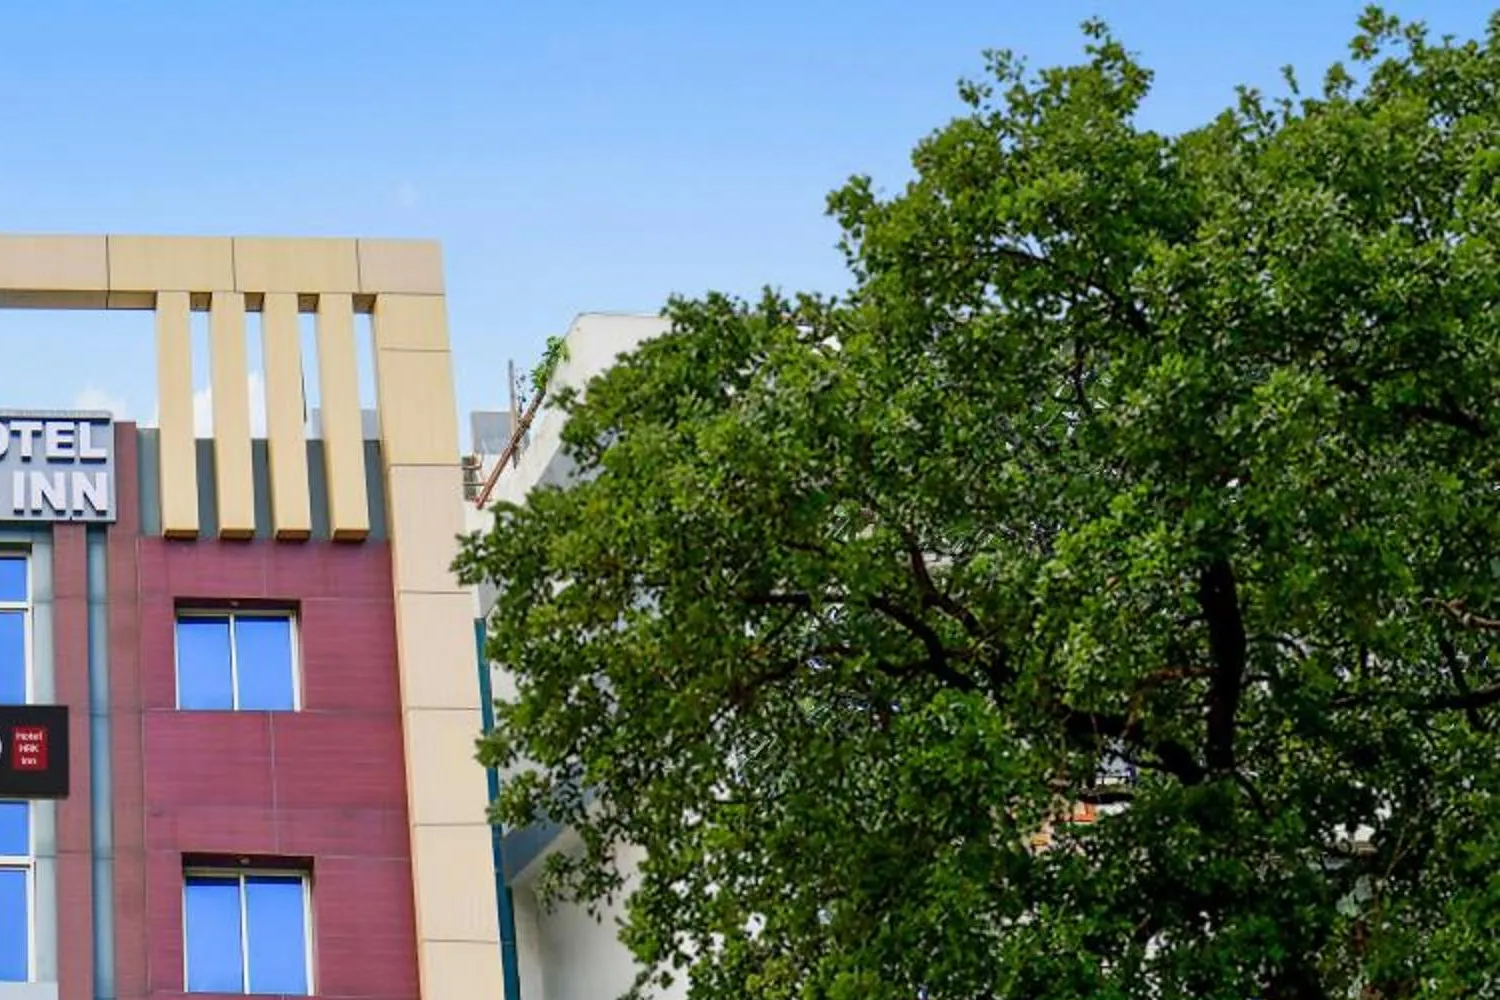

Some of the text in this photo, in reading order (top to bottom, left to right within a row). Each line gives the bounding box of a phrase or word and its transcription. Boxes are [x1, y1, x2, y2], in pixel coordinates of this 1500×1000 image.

[13, 470, 108, 516] INN
[15, 731, 43, 741] Hotel
[19, 743, 39, 753] HRK
[21, 755, 37, 765] Inn
